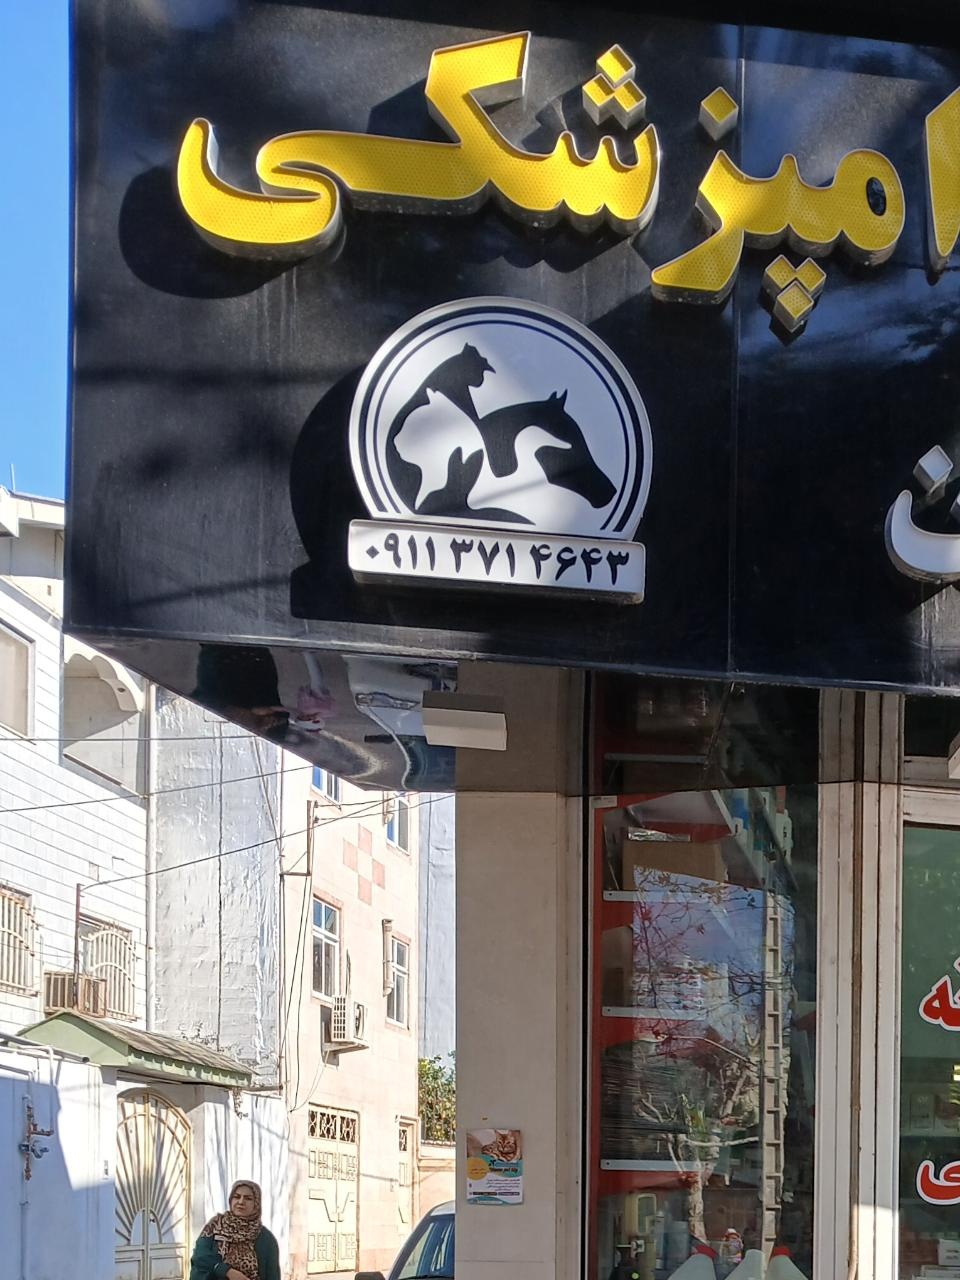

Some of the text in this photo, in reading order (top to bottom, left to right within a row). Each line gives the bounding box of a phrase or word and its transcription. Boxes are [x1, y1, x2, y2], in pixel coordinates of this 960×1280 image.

[366, 533, 630, 586] ۰۹۱۱ ۳۷۱ ۴۶۴۳
